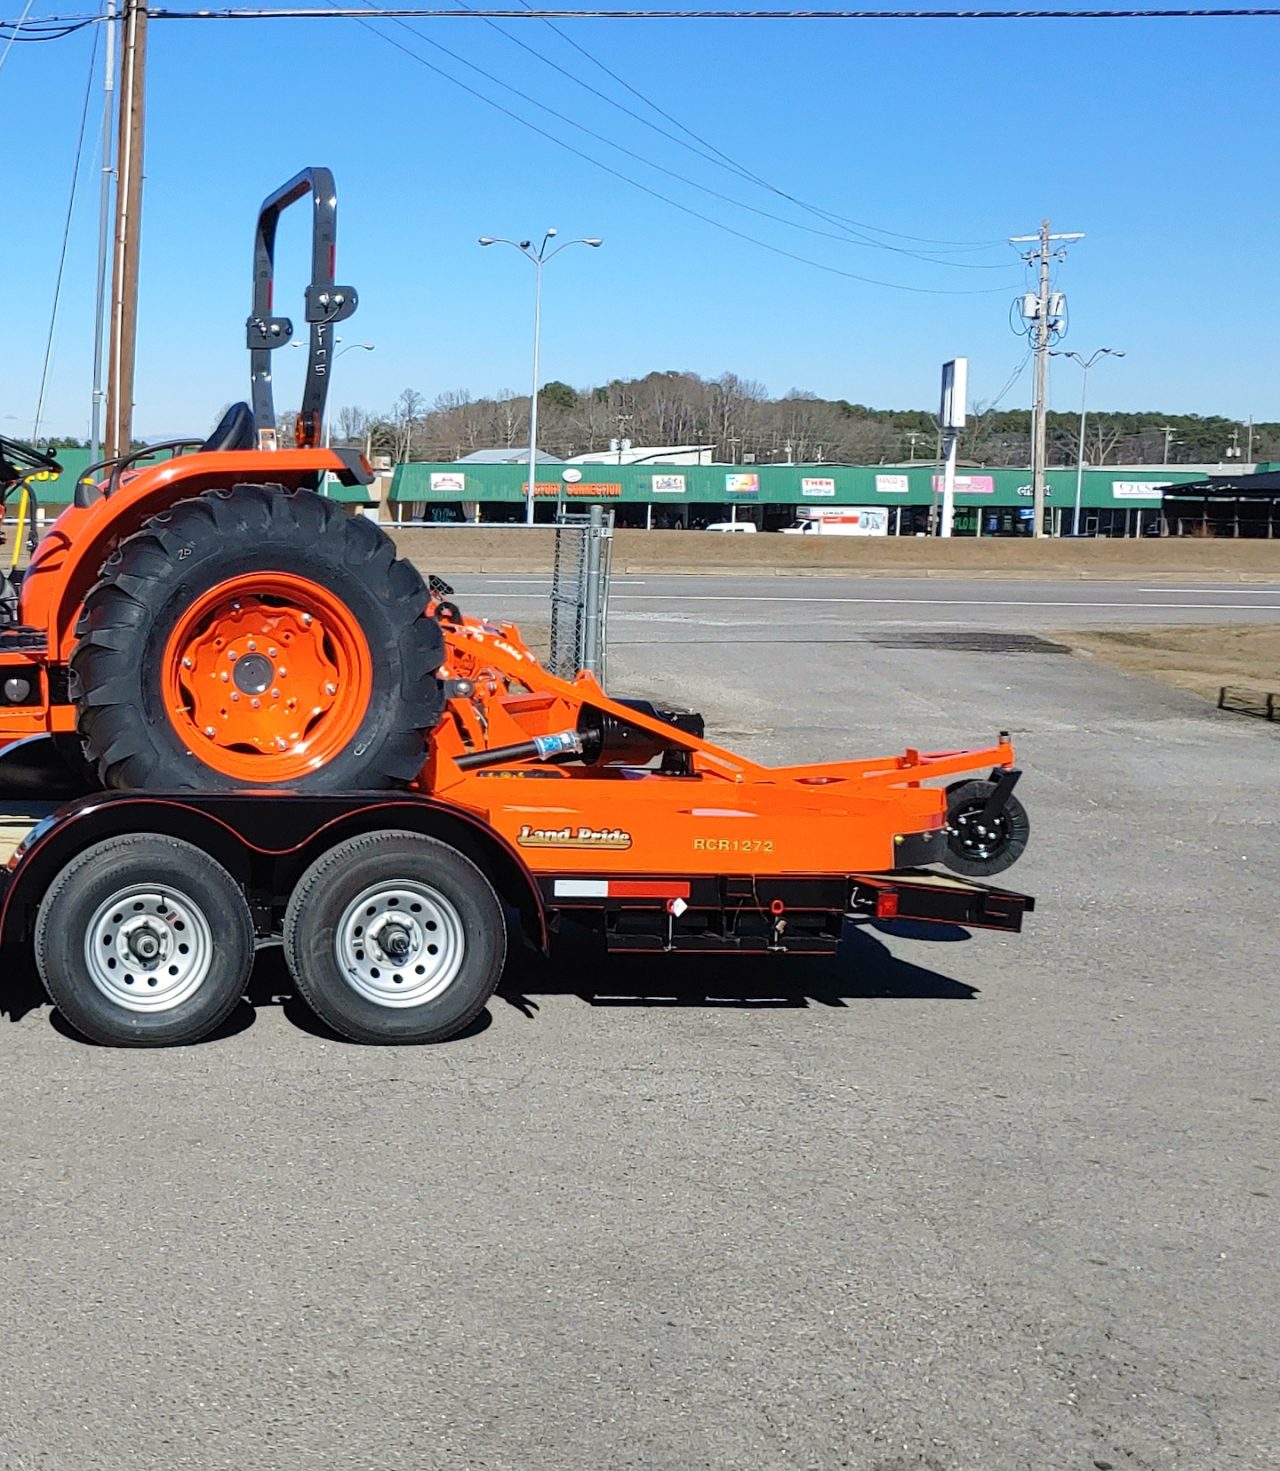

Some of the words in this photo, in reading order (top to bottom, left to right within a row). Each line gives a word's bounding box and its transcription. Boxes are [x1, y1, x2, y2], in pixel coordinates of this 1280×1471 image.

[520, 825, 571, 844] Land
[577, 827, 631, 845] Pride
[693, 838, 774, 852] RCR1272
